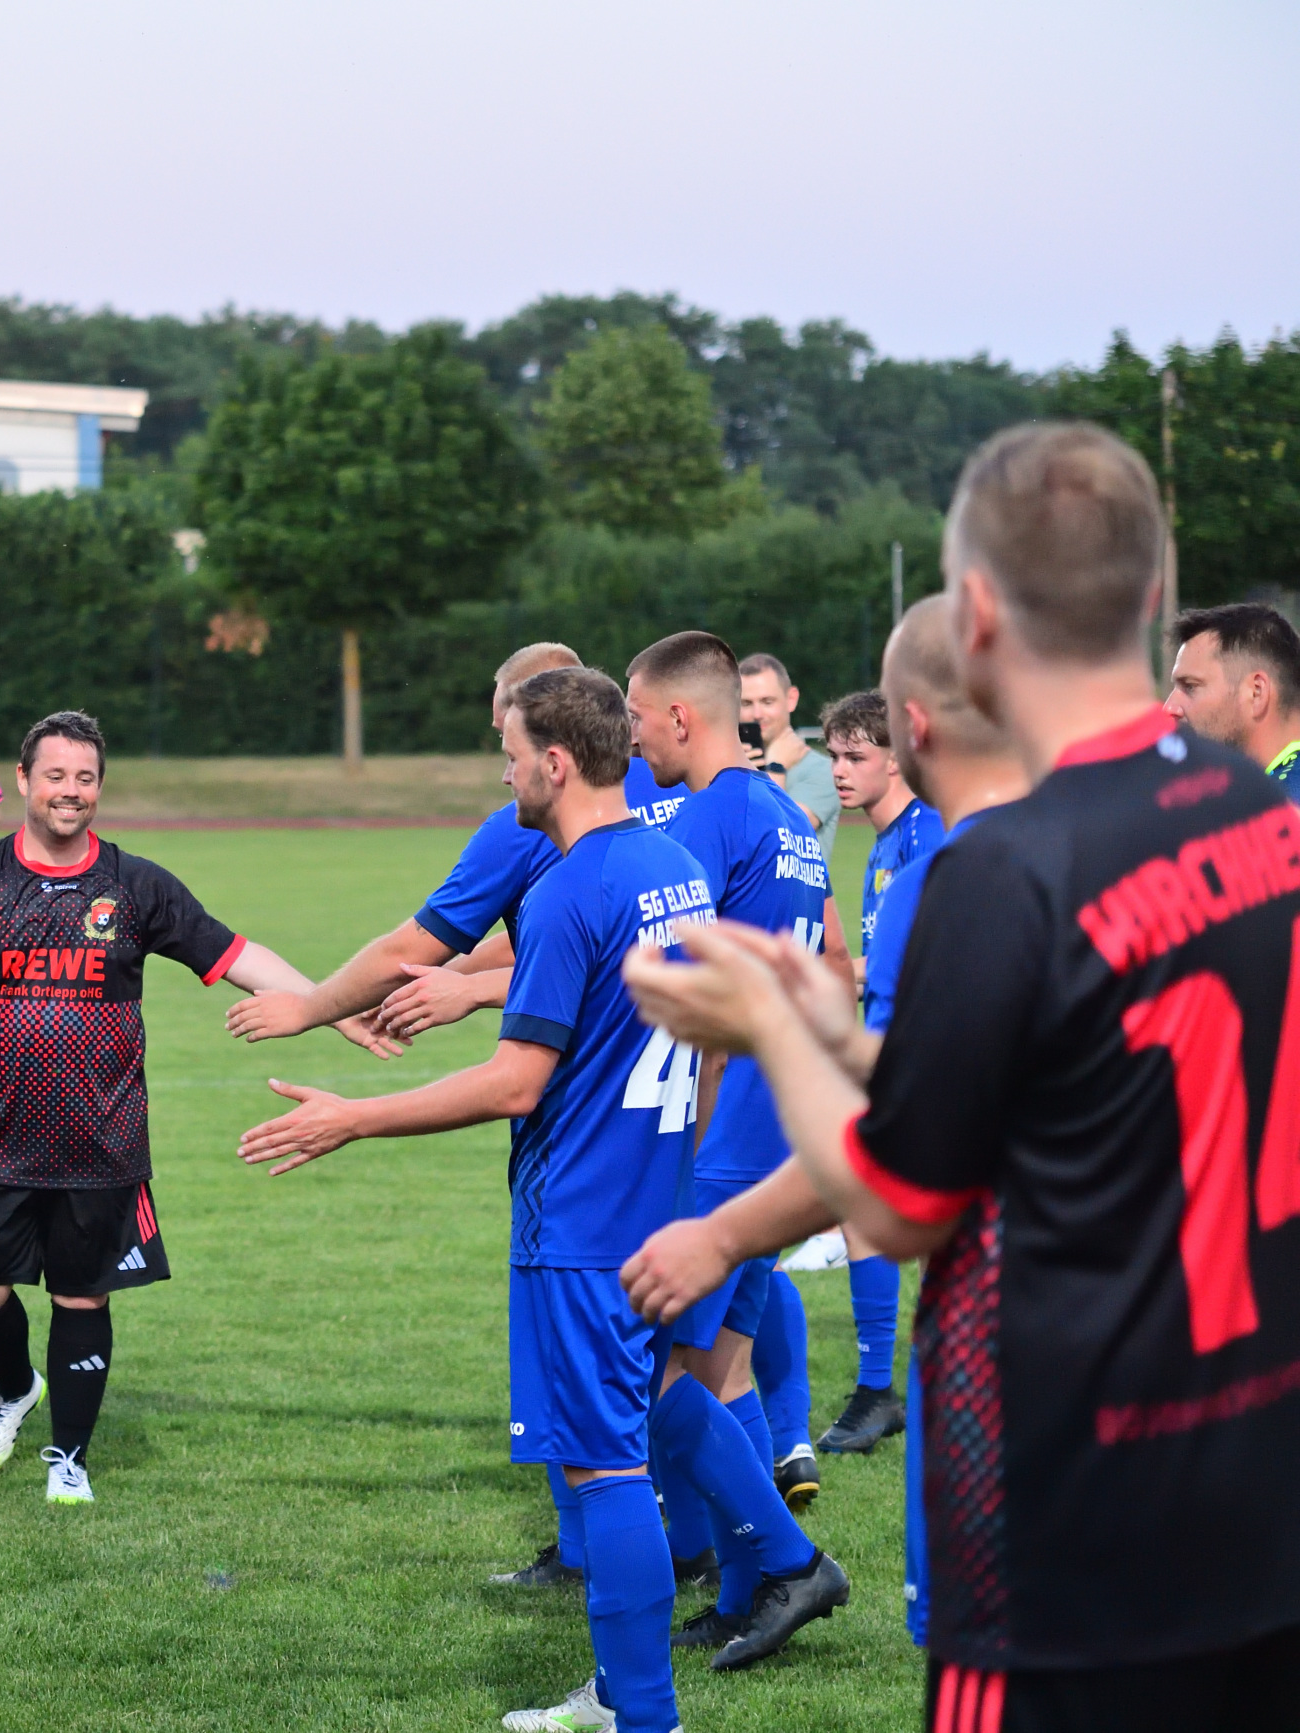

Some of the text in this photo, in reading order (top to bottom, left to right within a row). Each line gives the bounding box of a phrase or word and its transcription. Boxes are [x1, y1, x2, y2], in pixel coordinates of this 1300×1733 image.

[638, 889, 665, 922] SG
[2, 948, 106, 981] REWE
[31, 985, 77, 1000] Ortlepp
[80, 987, 103, 998] oHG
